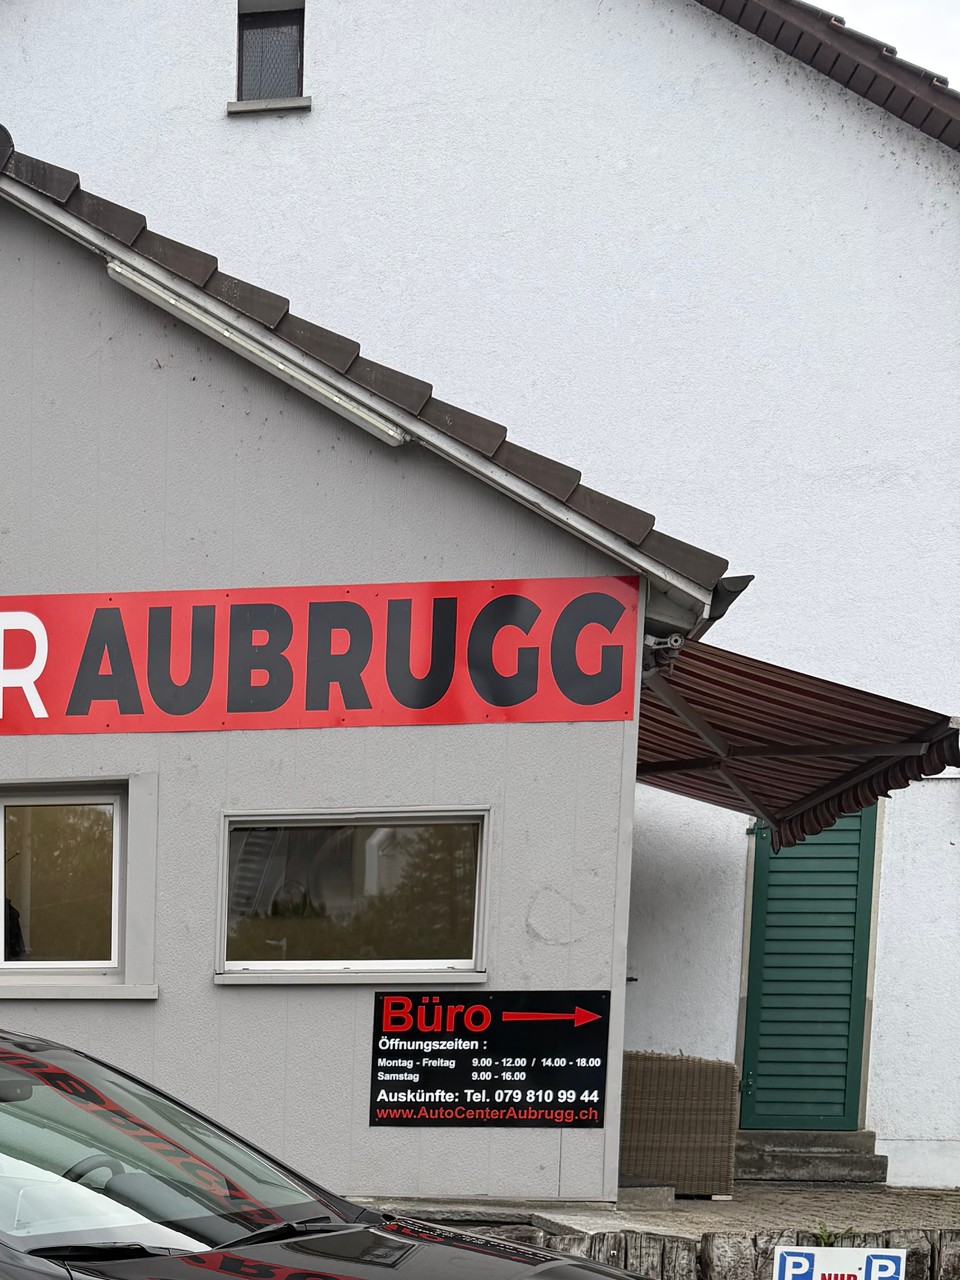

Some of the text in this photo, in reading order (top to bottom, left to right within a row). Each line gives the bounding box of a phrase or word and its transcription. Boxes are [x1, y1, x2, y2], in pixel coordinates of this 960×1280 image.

[65, 592, 627, 716] AUBRUGG
[382, 996, 492, 1033] Büro
[378, 1036, 479, 1052] Öffnungszeiten
[377, 1058, 414, 1069] Montag
[422, 1058, 456, 1069] Freitag
[472, 1058, 492, 1067] 9.00
[501, 1058, 527, 1067] 12.00
[541, 1058, 566, 1067] 14.00
[575, 1058, 601, 1067] 18.00
[377, 1071, 420, 1082] Samstag
[471, 1072, 492, 1081] 9.00
[501, 1072, 526, 1081] 16.00
[376, 1089, 599, 1103] Auskünfte: Tel. 079 810 99 44
[376, 1106, 599, 1123] www.AutoCenterAubrugg.ch
